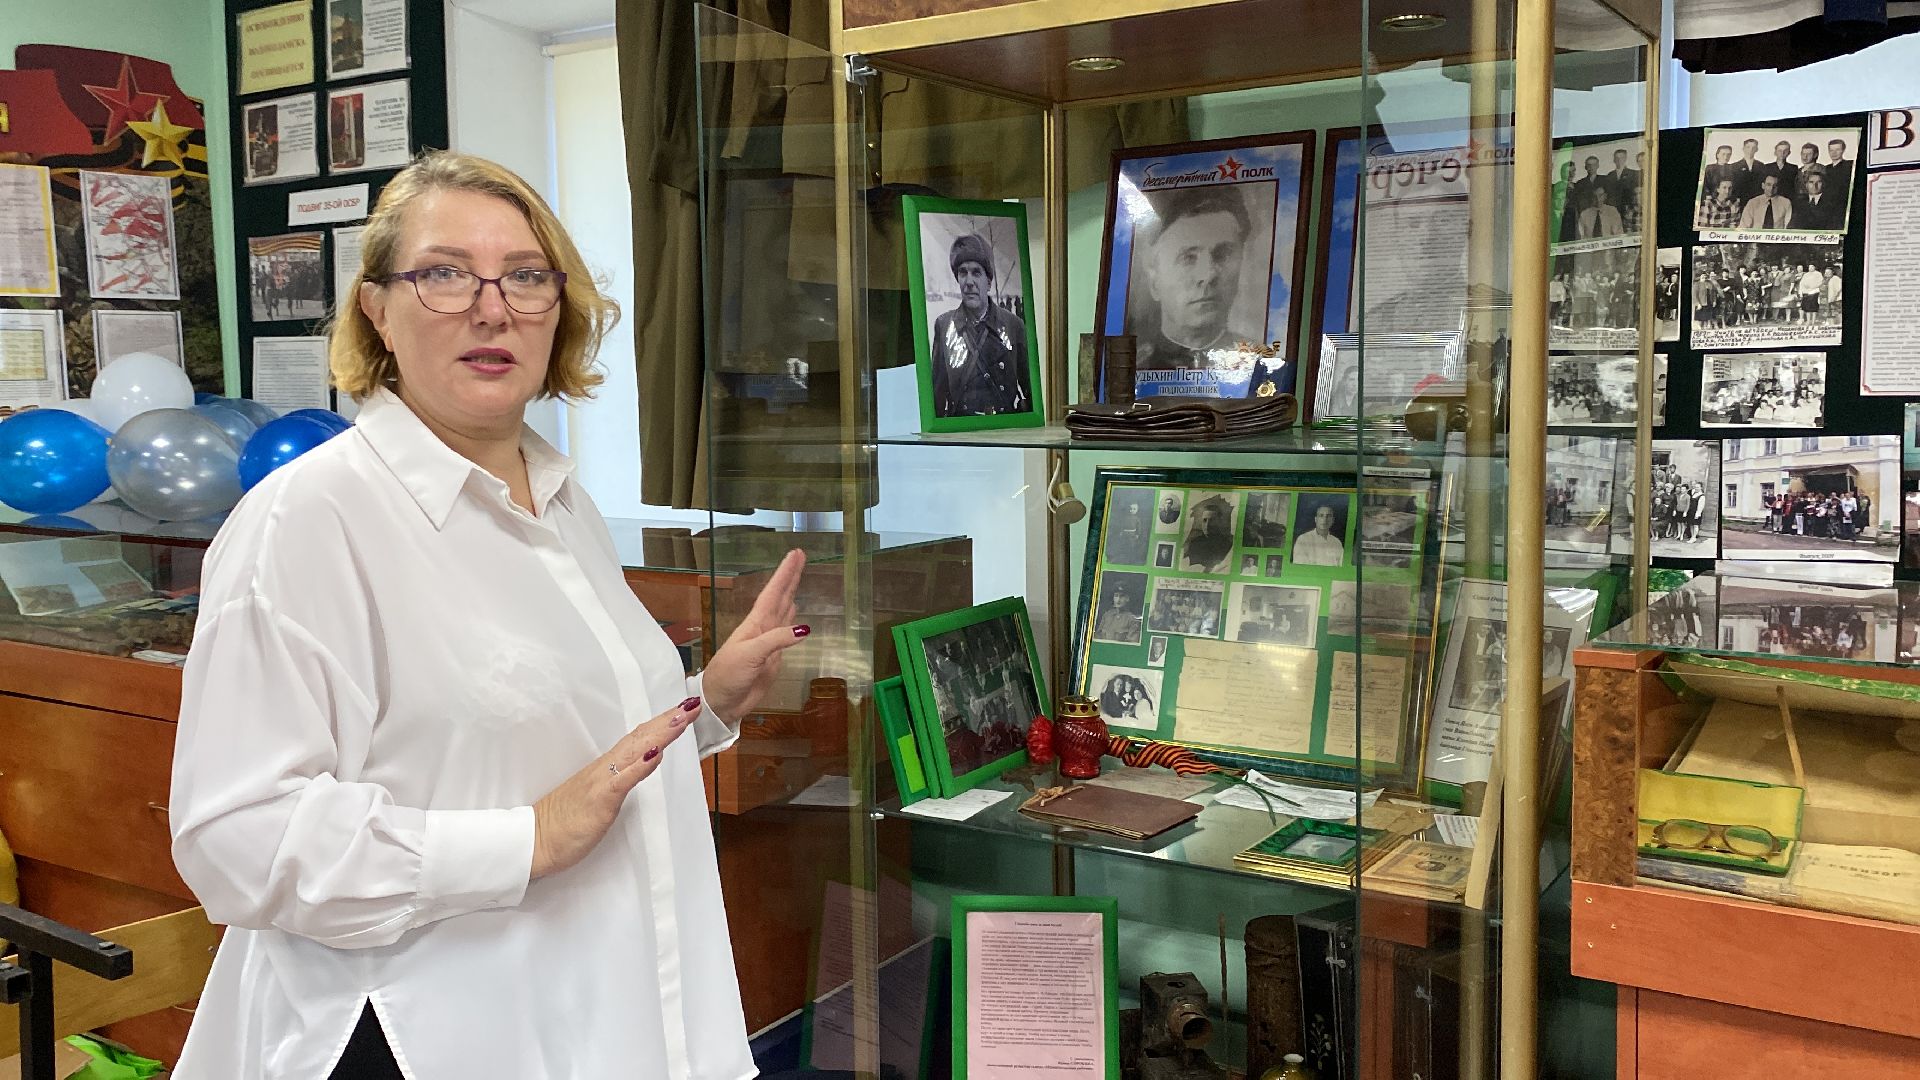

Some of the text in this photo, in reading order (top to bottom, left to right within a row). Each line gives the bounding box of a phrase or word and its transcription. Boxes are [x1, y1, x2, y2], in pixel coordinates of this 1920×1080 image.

[1708, 231, 1728, 240] Они
[1135, 370, 1174, 382] удыхин
[1177, 367, 1203, 385] Петр
